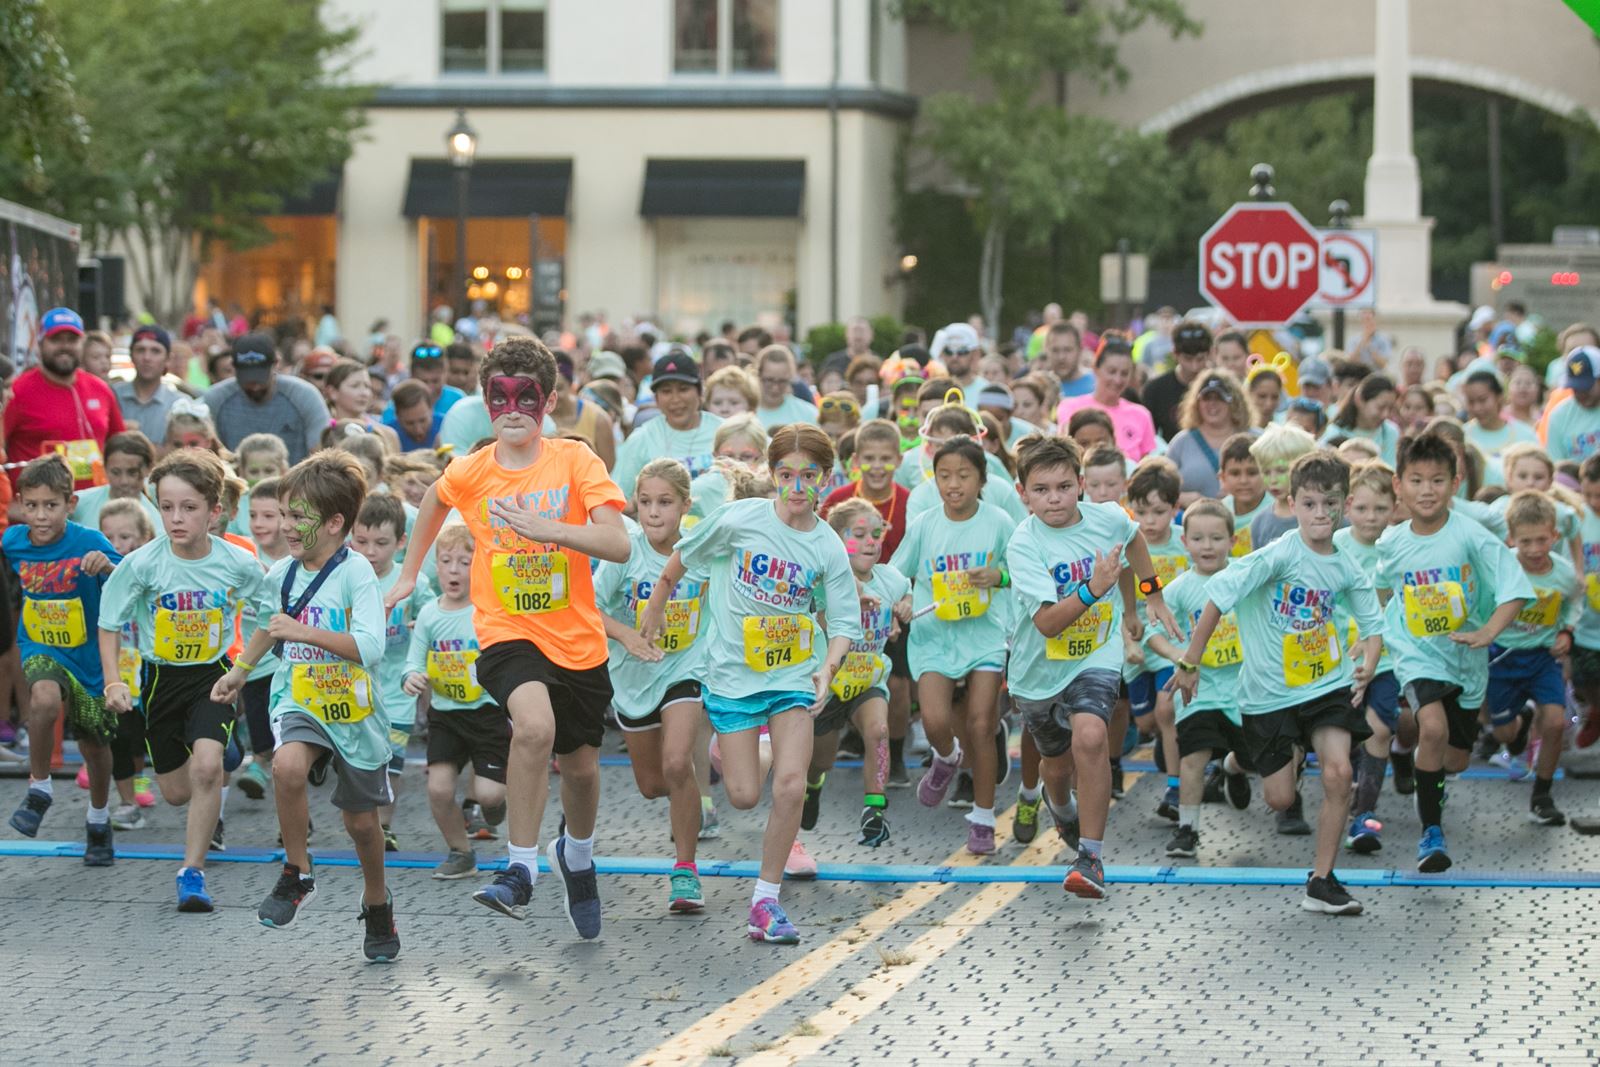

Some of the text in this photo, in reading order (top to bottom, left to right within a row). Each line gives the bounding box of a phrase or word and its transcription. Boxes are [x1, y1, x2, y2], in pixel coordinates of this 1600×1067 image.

[1209, 241, 1316, 290] STOP
[517, 568, 552, 578] GLOW
[736, 548, 802, 584] LIGHT
[738, 566, 760, 587] THE
[514, 592, 552, 611] 1082
[754, 588, 793, 608] GLOW
[957, 601, 971, 616] 16
[176, 623, 208, 633] GLOW
[1424, 616, 1450, 633] 882
[40, 630, 71, 645] 1310
[767, 628, 799, 639] GLOW
[175, 643, 201, 659] 377
[289, 647, 325, 661] GLOW
[1068, 639, 1092, 656] 555
[1215, 645, 1239, 664] 214
[766, 647, 791, 667] 674
[1309, 661, 1324, 679] 75
[317, 679, 352, 689] GLOW
[444, 684, 466, 699] 378
[843, 684, 864, 699] 811
[321, 702, 351, 721] 180
